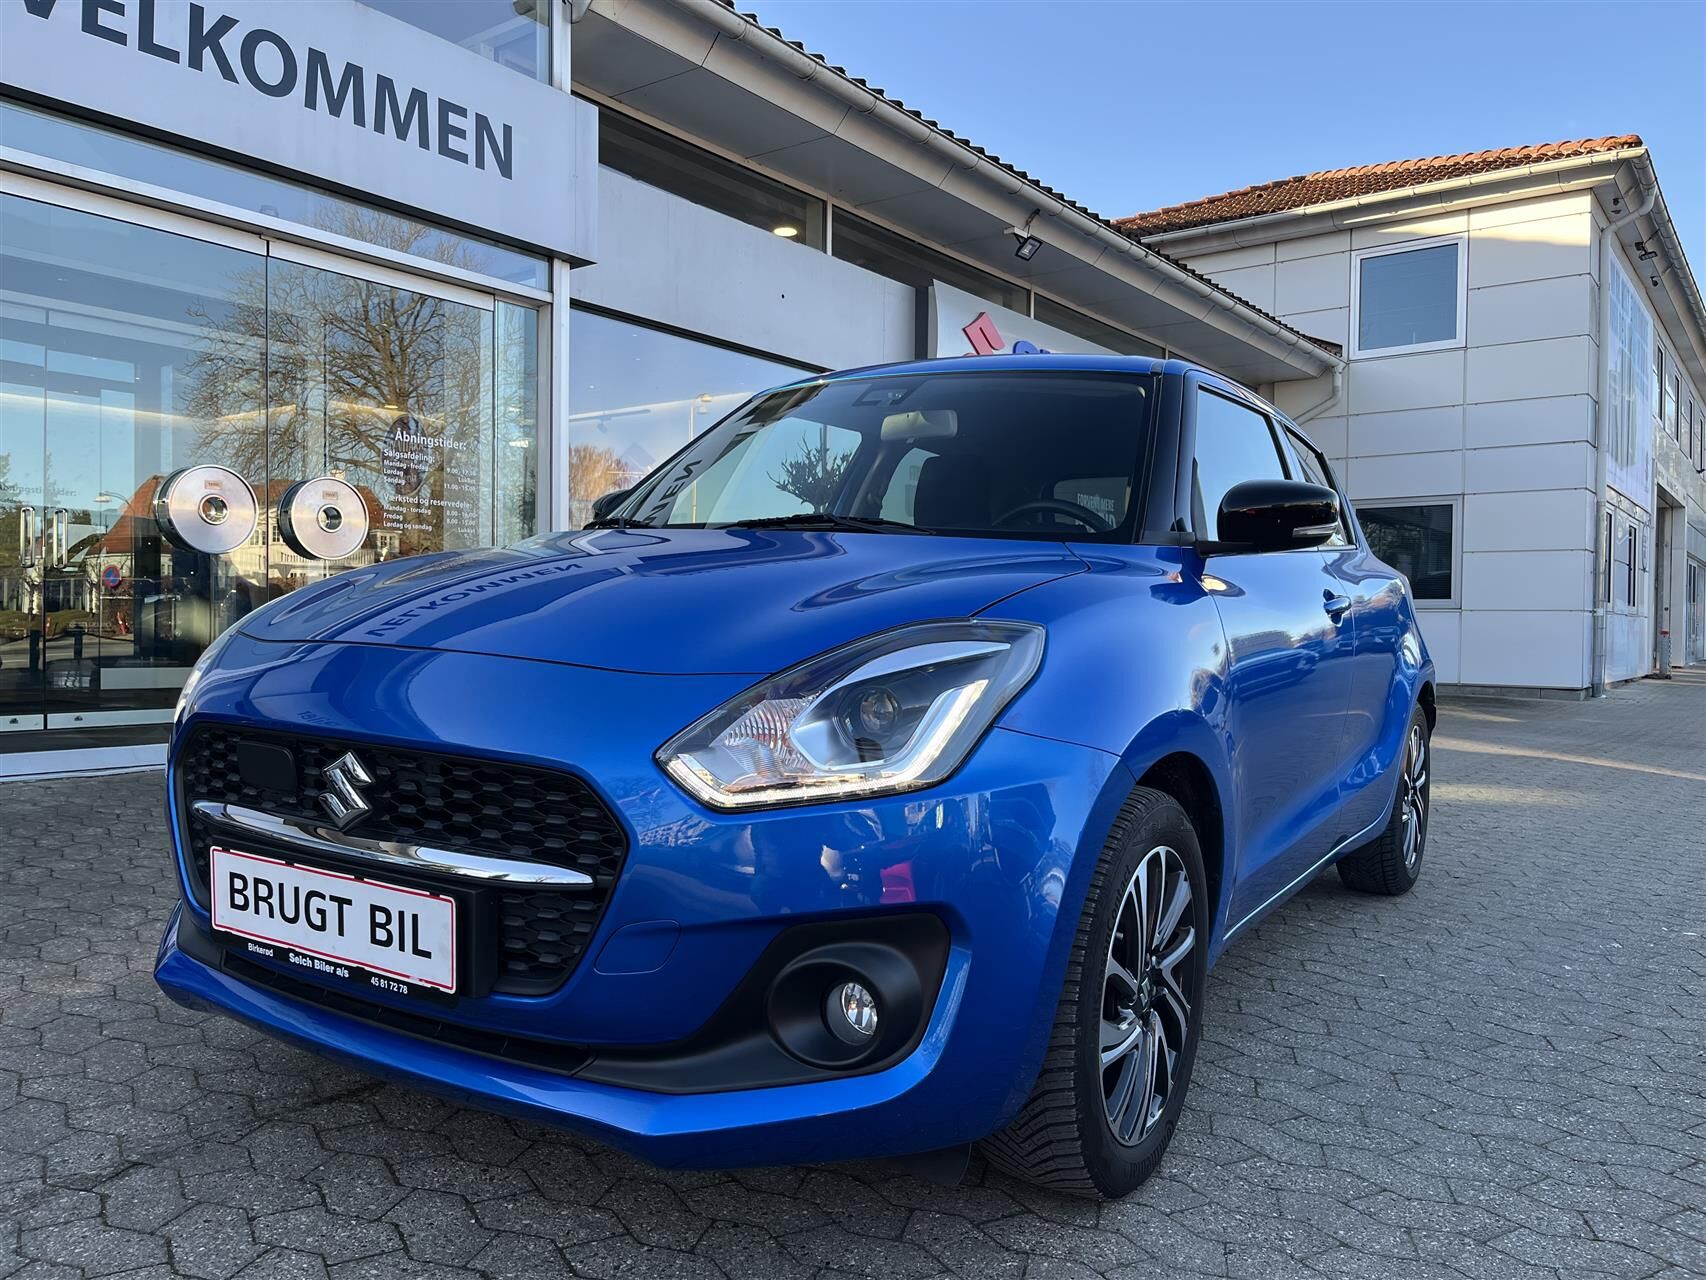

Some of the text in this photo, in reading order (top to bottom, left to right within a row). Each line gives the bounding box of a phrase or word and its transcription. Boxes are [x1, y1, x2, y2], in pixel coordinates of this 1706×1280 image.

[395, 427, 467, 450] Åbningstider:
[383, 449, 435, 463] Salgsafdeling:
[229, 871, 432, 960] BRUGT BIL
[289, 952, 350, 978] Selch Biler a/s
[370, 976, 408, 994] 45 81 72 78
